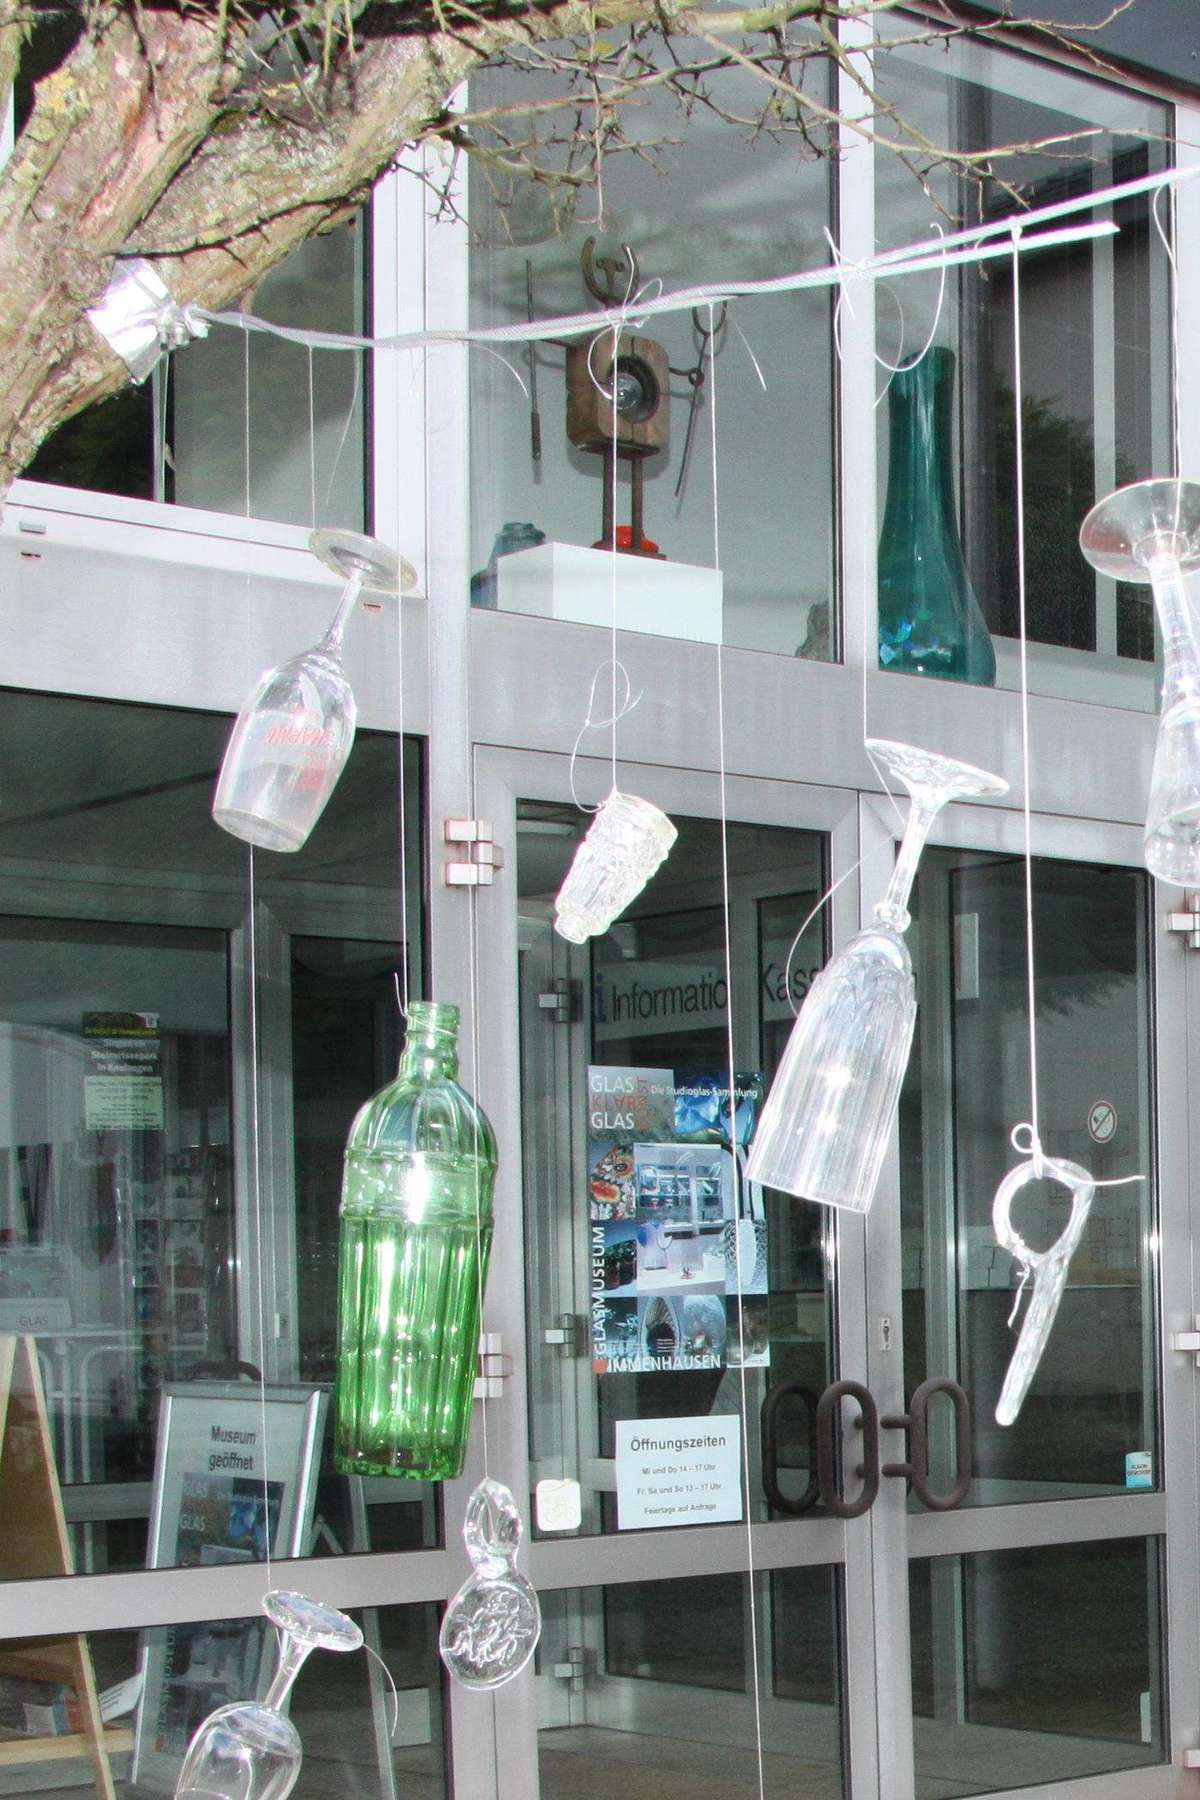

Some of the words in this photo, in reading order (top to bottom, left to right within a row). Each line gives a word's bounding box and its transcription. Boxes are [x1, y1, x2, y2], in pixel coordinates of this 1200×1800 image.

[612, 972, 729, 1022] Informatio
[590, 1074, 635, 1094] GLAS
[590, 1111, 635, 1130] GLAS
[592, 1226, 606, 1355] GLASMUSEUM
[607, 1355, 721, 1373] IMMENHAUSEN
[211, 1425, 256, 1445] Museum
[630, 1434, 726, 1452] Öffnungszeiten
[208, 1452, 254, 1471] geöffnet
[642, 1467, 651, 1475] Mi
[653, 1466, 666, 1475] und
[667, 1466, 677, 1474] Do
[680, 1465, 688, 1473] 14
[695, 1464, 702, 1472] 17
[703, 1464, 717, 1472] Uhr
[648, 1487, 657, 1495] Sa
[659, 1486, 673, 1495] und
[674, 1485, 684, 1493] So
[701, 1483, 708, 1491] 17
[709, 1482, 722, 1490] Uhr
[644, 1506, 676, 1516] Feiertage
[678, 1504, 689, 1513] auf
[690, 1503, 717, 1513] Anfrage
[180, 1514, 207, 1532] GLAS
